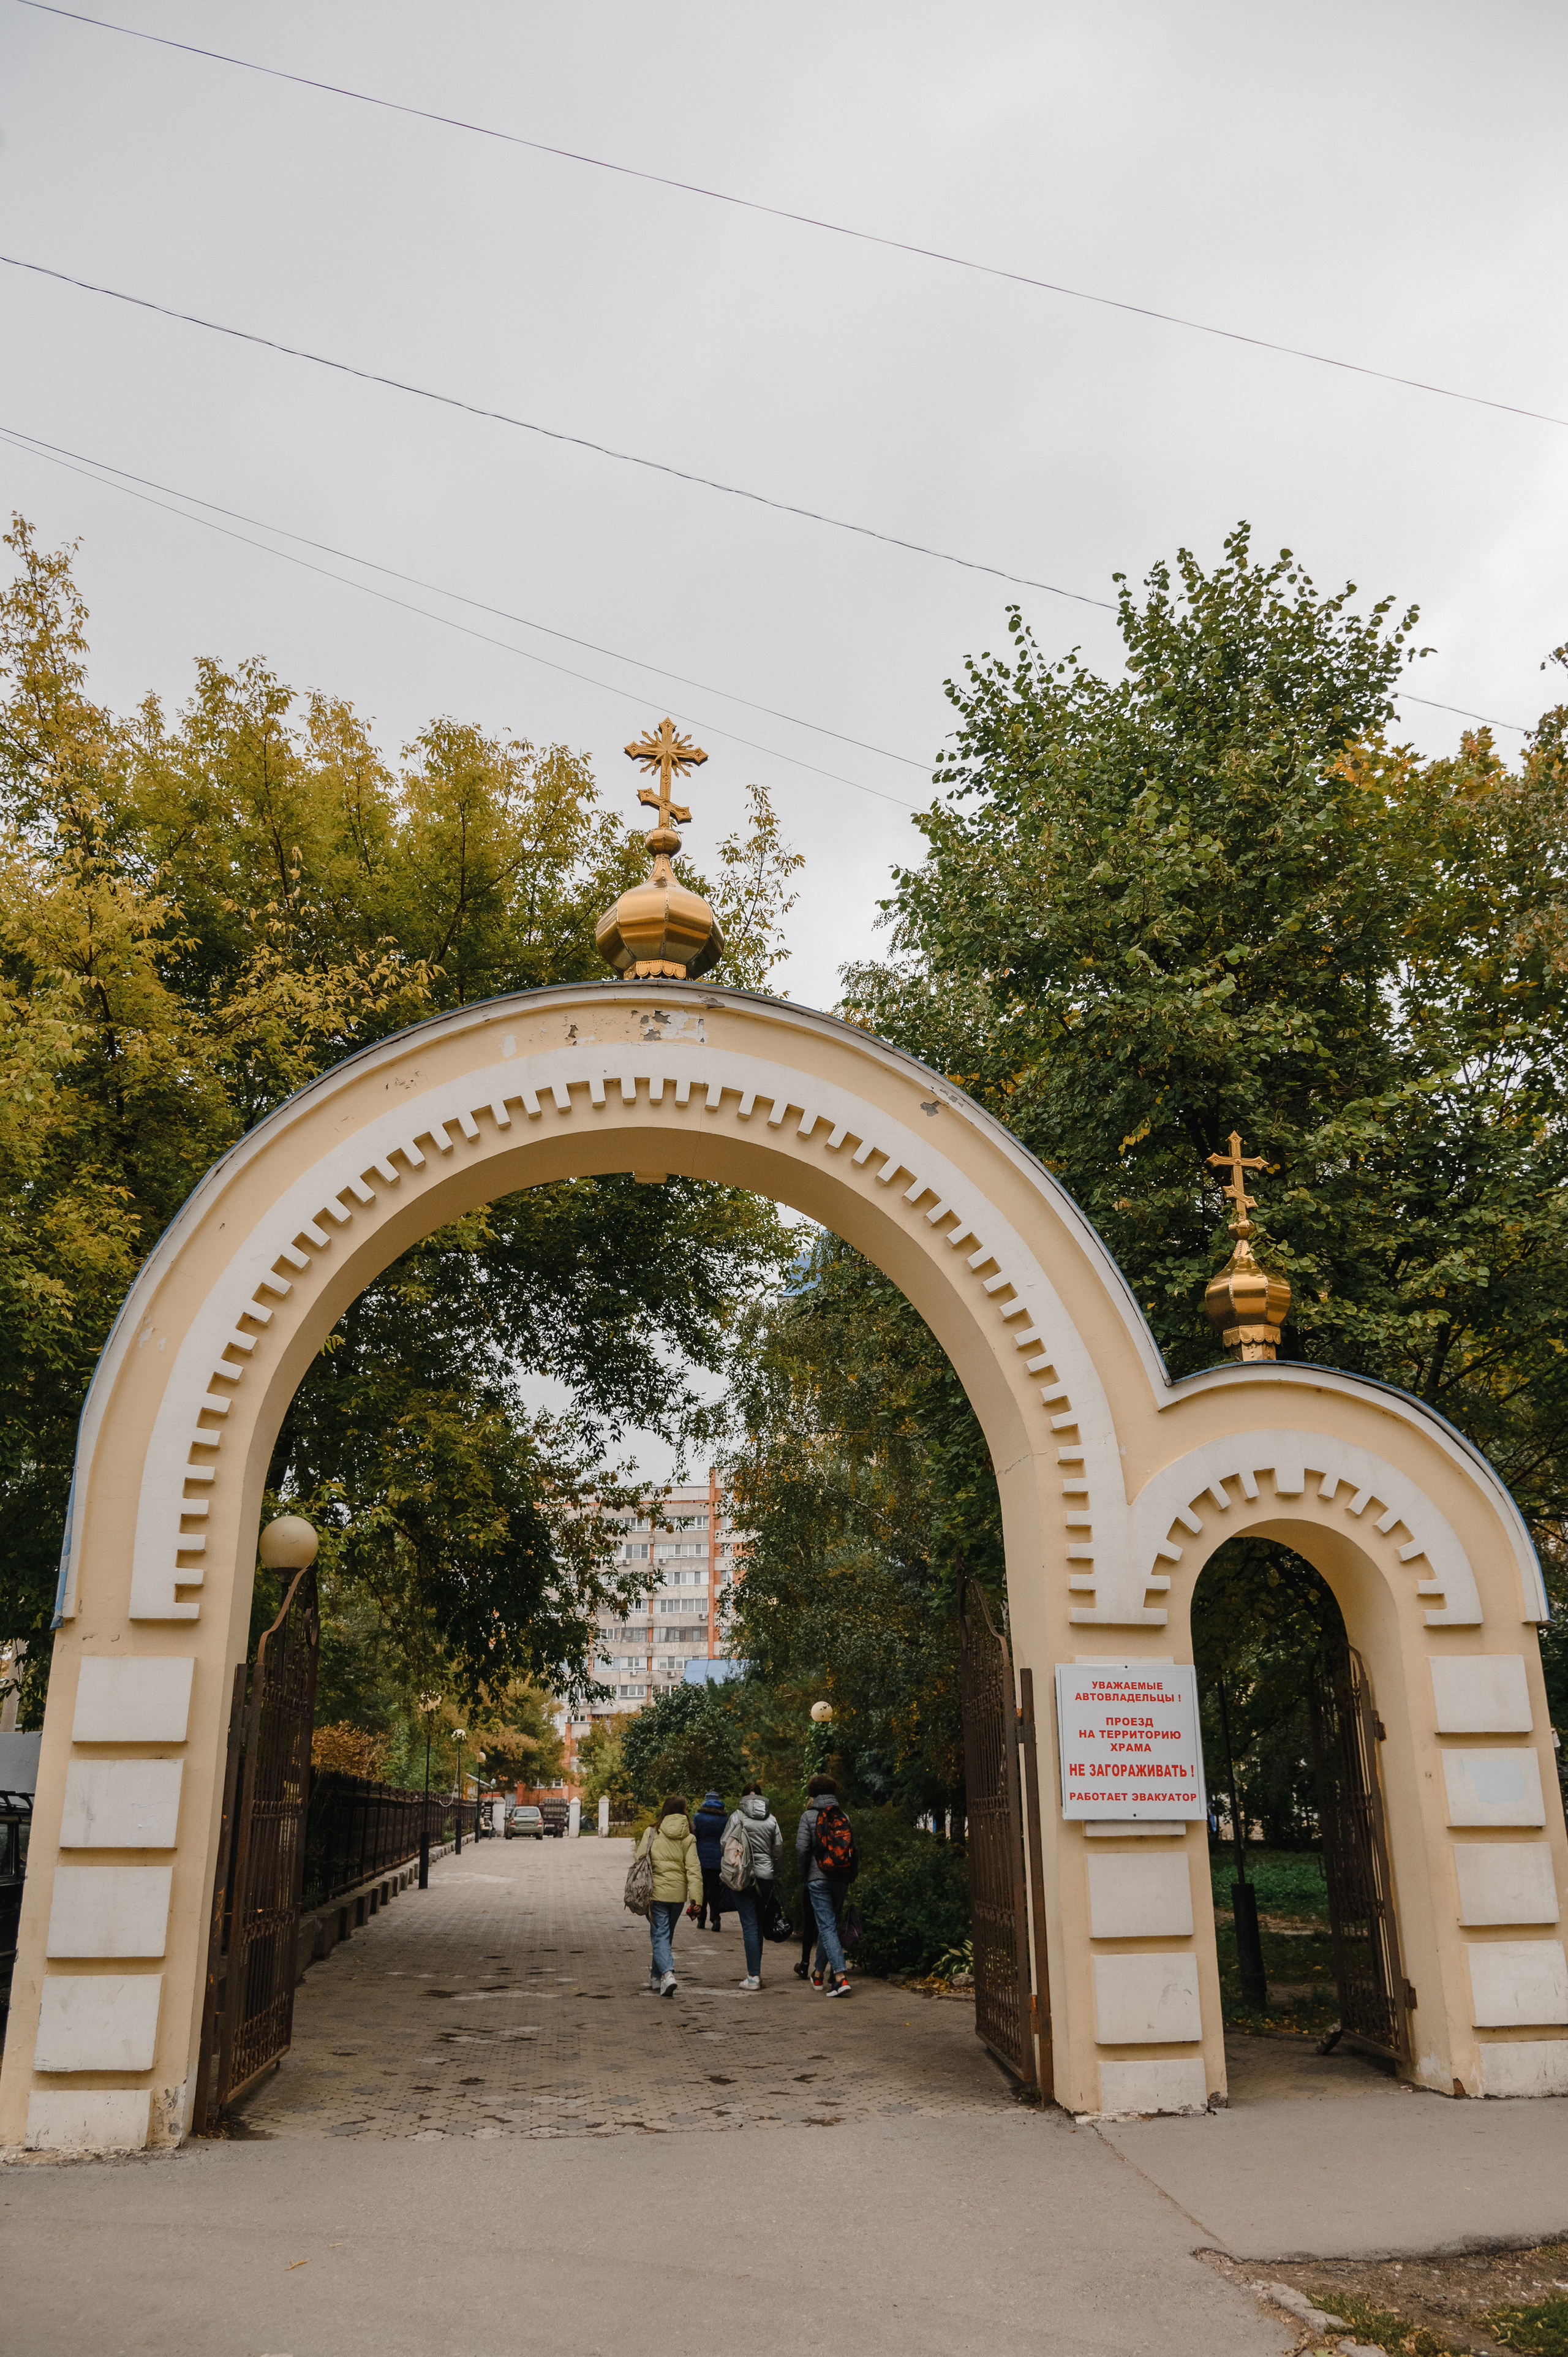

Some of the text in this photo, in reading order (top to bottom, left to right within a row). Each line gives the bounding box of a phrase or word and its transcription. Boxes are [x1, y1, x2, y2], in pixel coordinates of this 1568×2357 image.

[1091, 1681, 1163, 1690] УВАЖАЕМЫЕ
[1106, 1717, 1153, 1728] ПРОЕЗД
[1099, 1730, 1181, 1739] ТЕРРИТОРИЮ
[1110, 1743, 1152, 1752] ХРАМА
[1069, 1763, 1085, 1776] НЕ
[1069, 1792, 1197, 1801] РАБОТАЕТ ЭВАКУАТОР
